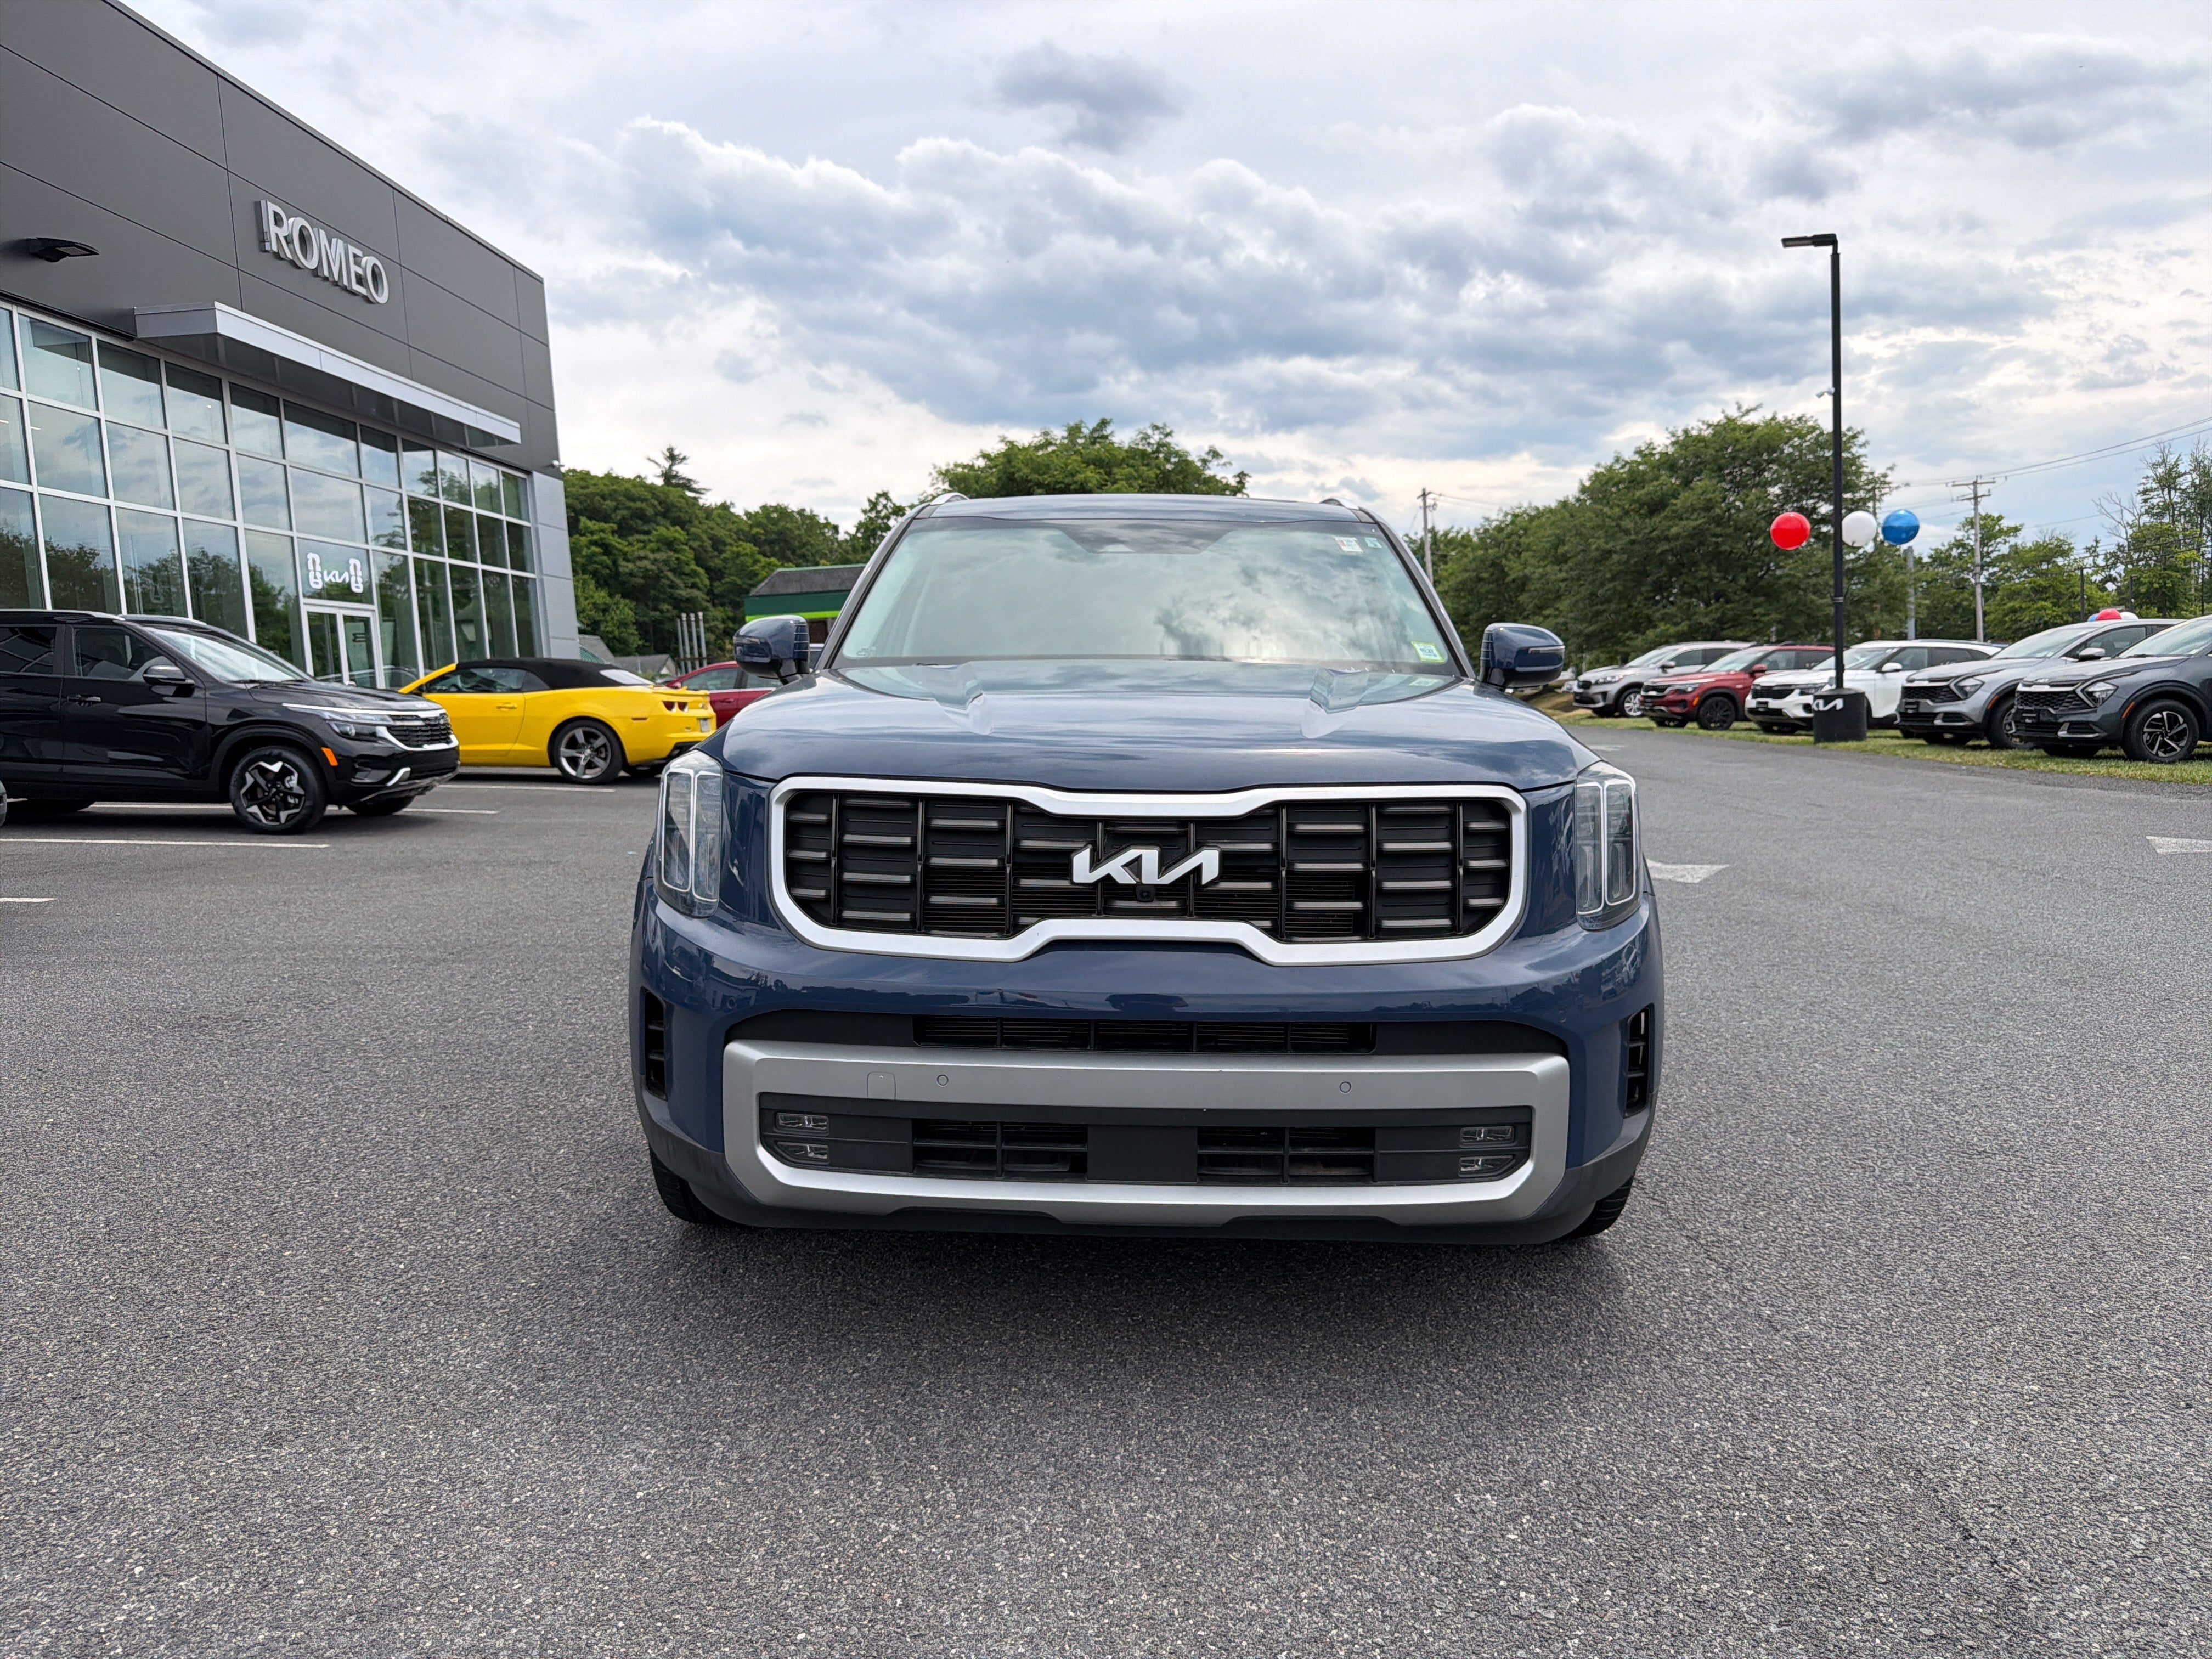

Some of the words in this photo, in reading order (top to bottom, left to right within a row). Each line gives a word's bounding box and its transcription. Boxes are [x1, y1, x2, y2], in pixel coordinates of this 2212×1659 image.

[261, 200, 389, 304] ROMEO
[323, 569, 349, 584] KIA
[1073, 847, 1220, 885] KIA
